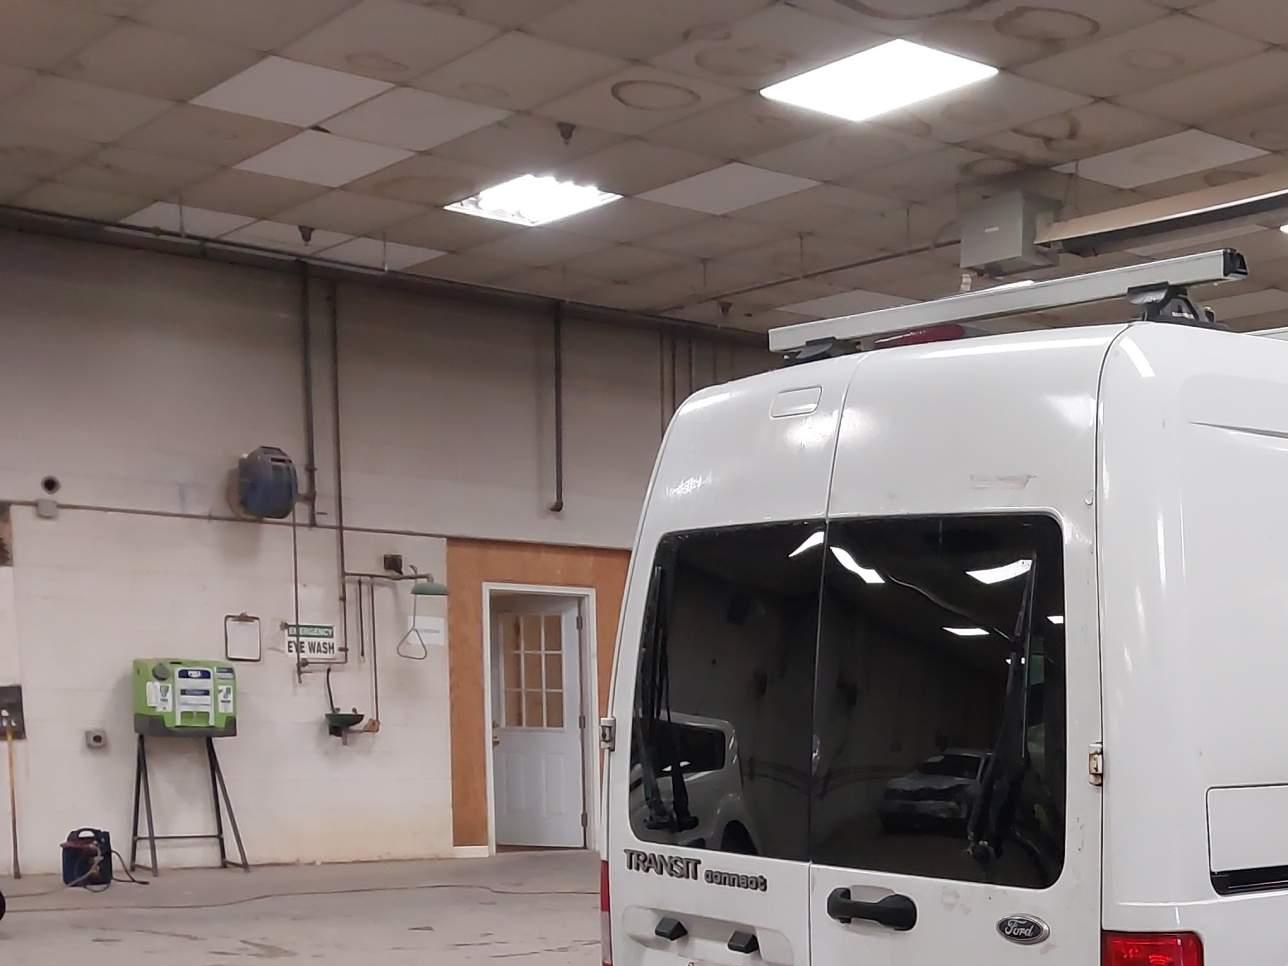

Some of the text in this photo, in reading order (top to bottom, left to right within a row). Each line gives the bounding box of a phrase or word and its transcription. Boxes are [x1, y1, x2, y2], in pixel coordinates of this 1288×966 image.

[308, 641, 335, 655] WASH
[624, 849, 702, 881] TRANSIT
[1004, 918, 1035, 937] Ford
